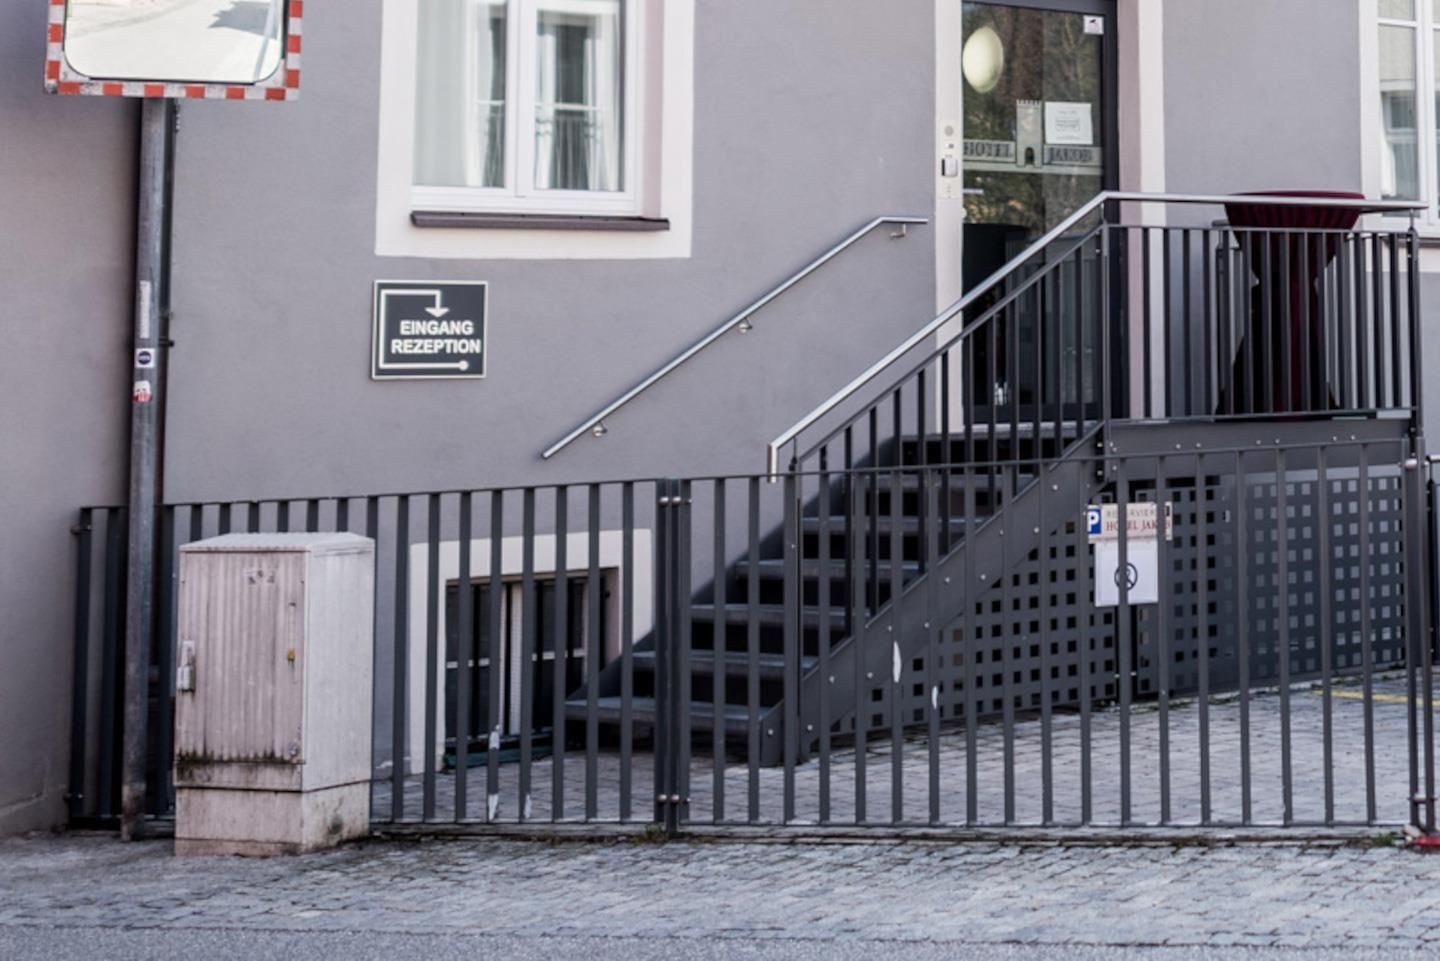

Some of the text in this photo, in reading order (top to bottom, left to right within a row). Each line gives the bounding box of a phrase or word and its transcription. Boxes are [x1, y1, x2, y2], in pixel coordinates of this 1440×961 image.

[400, 320, 473, 335] EINGANG
[391, 338, 481, 354] REZEPTION
[1087, 511, 1100, 532] P
